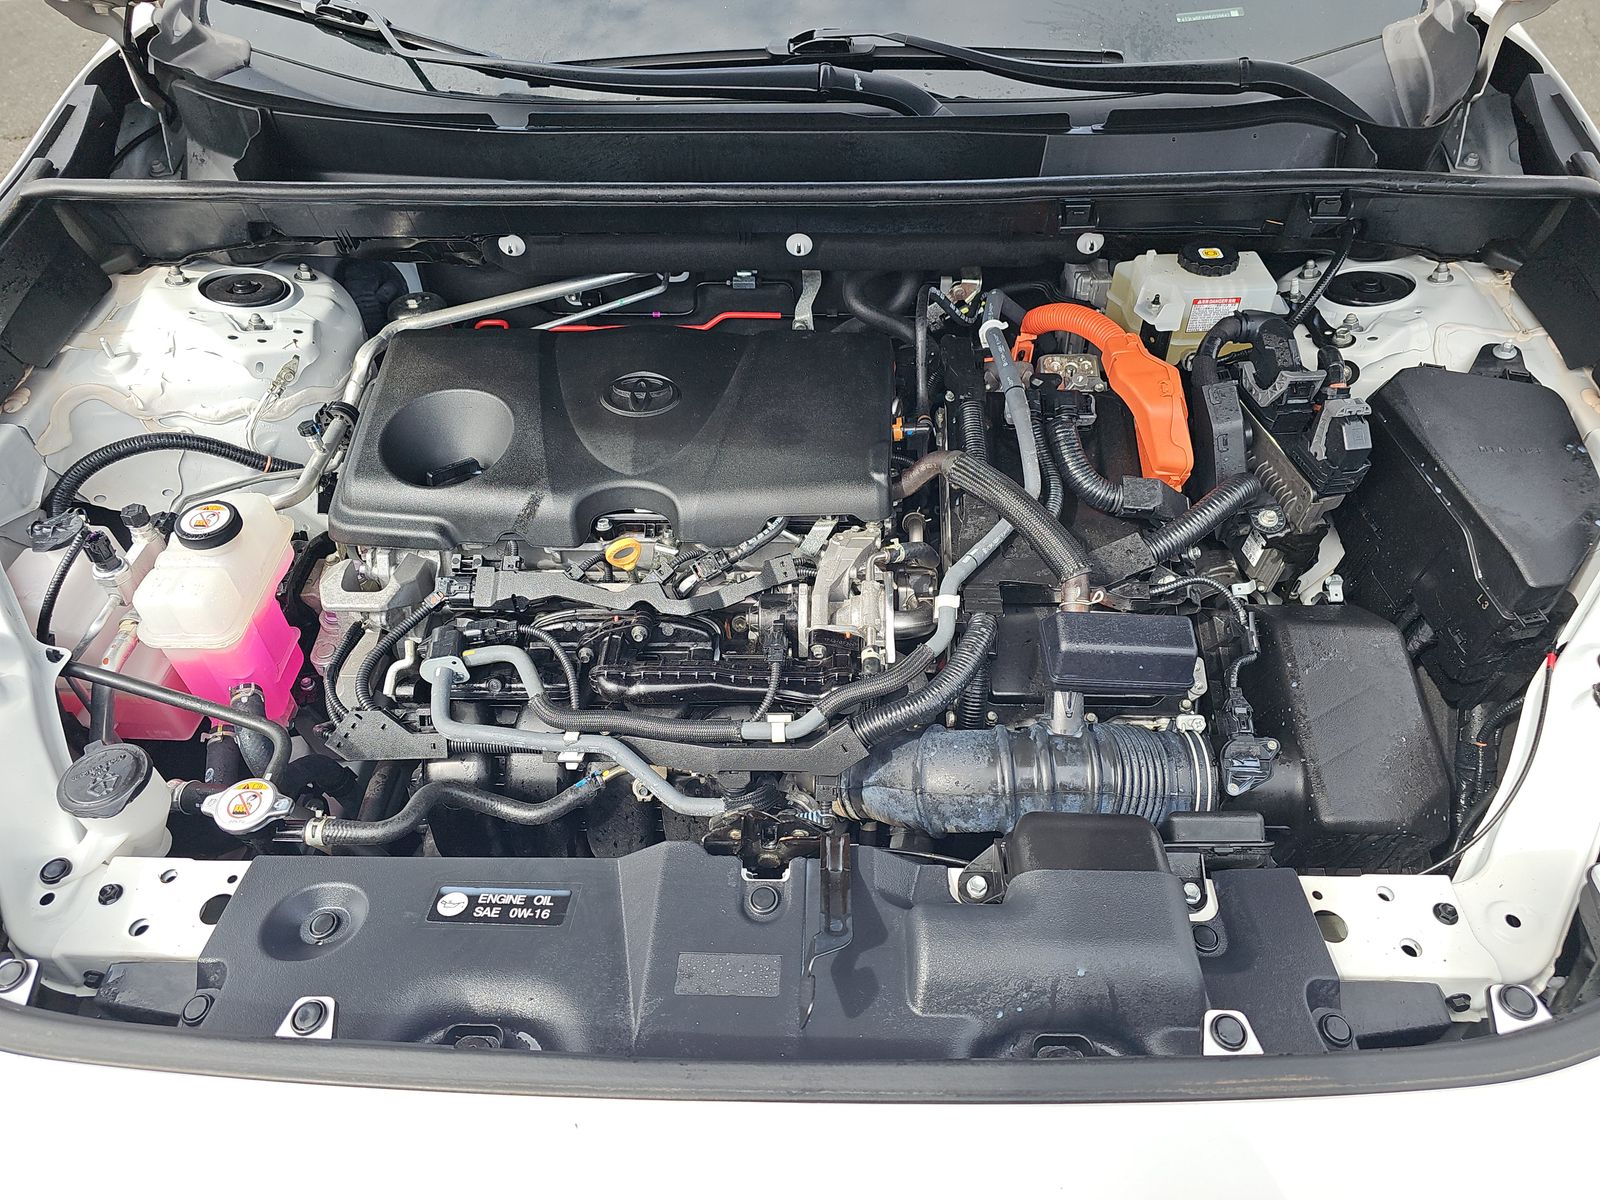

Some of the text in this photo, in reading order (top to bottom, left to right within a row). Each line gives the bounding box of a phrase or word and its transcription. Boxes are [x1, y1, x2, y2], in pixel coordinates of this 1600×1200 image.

[478, 894, 554, 906] ENGINE OIL
[473, 907, 550, 919] SAE 0W-16
